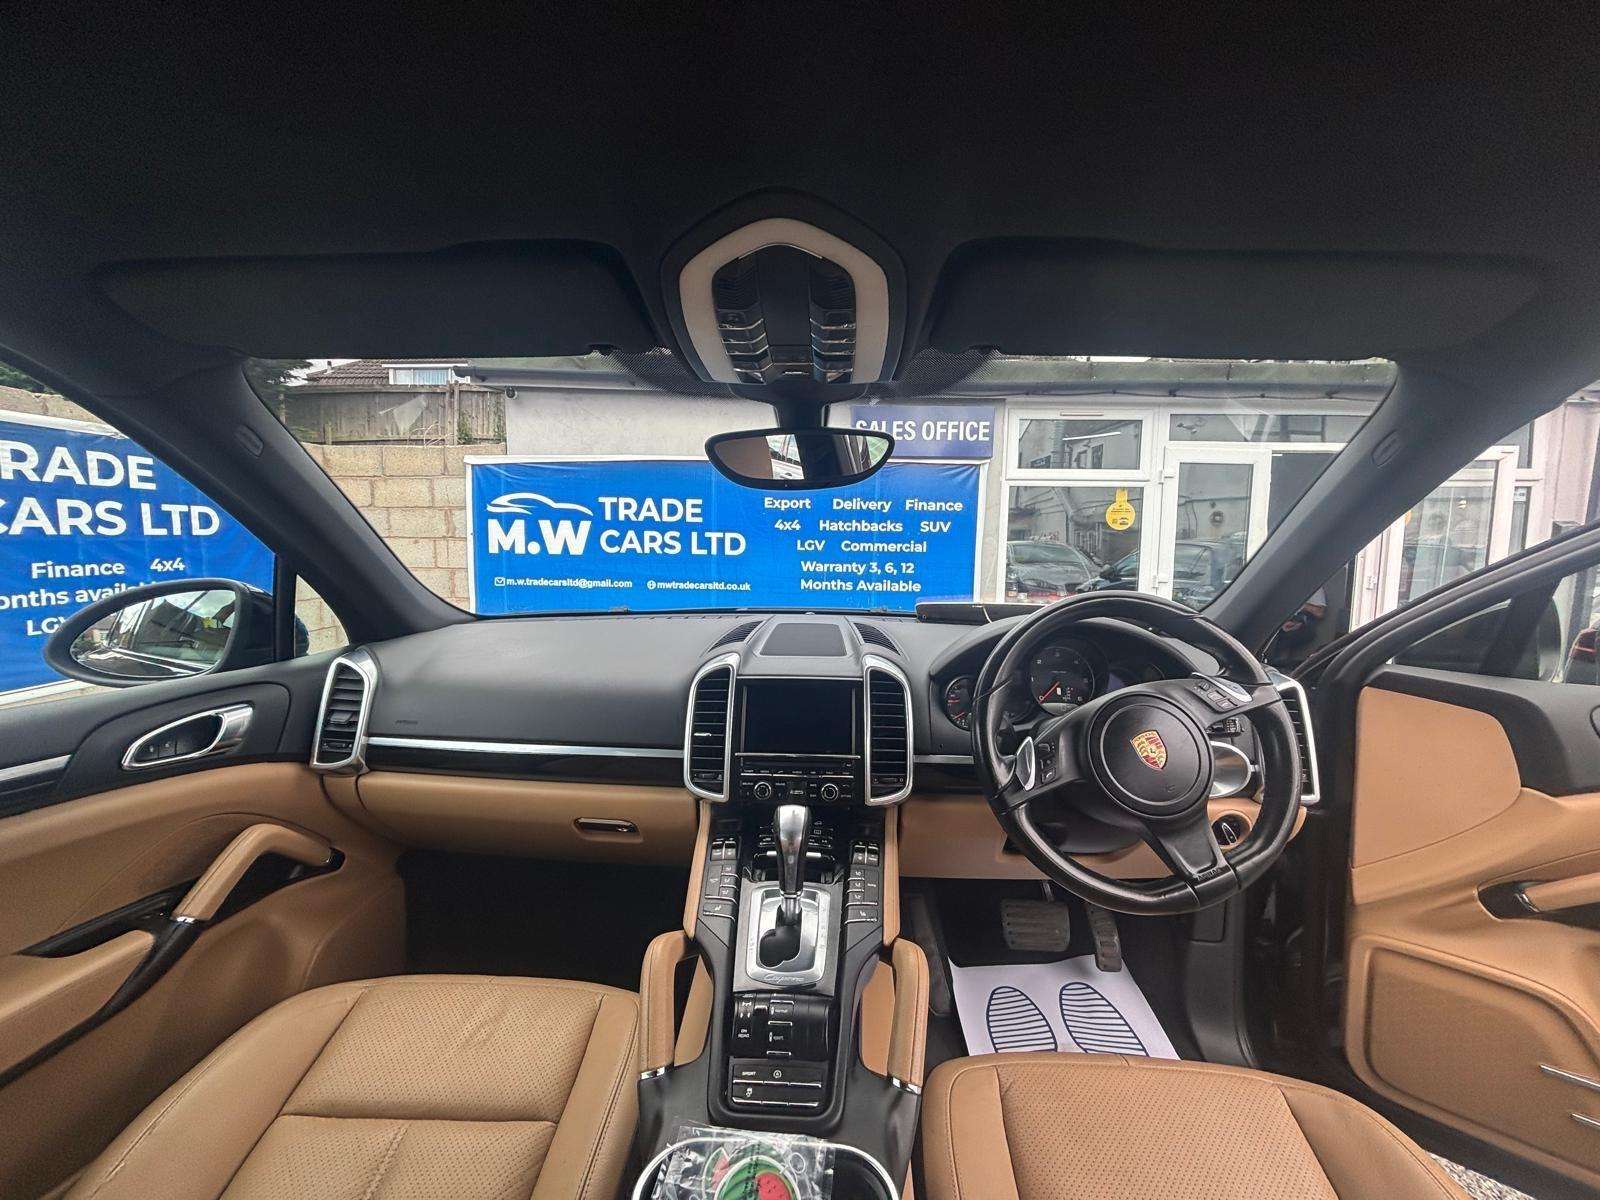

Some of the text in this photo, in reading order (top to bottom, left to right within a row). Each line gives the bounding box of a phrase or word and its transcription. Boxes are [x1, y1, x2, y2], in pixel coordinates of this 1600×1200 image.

[921, 421, 991, 441] OFFICE
[598, 496, 704, 523] TRADE
[764, 497, 964, 512] Export Delivery Finance
[140, 502, 220, 536] LTD
[774, 519, 952, 533] 4x4 Hatchbacks SUV
[487, 519, 592, 556] M.W
[600, 529, 747, 556] CARS LTD
[797, 540, 928, 553] LGV Commercial
[31, 557, 186, 579] Finance 4x4
[801, 561, 915, 575] Warranty 3, 6, 12
[506, 578, 633, 589] m.w.tradecarsltd@gmail.com
[657, 581, 751, 591] mwtradecarsltd.co.uk
[800, 580, 922, 593] Months Available
[26, 616, 67, 636] LG
